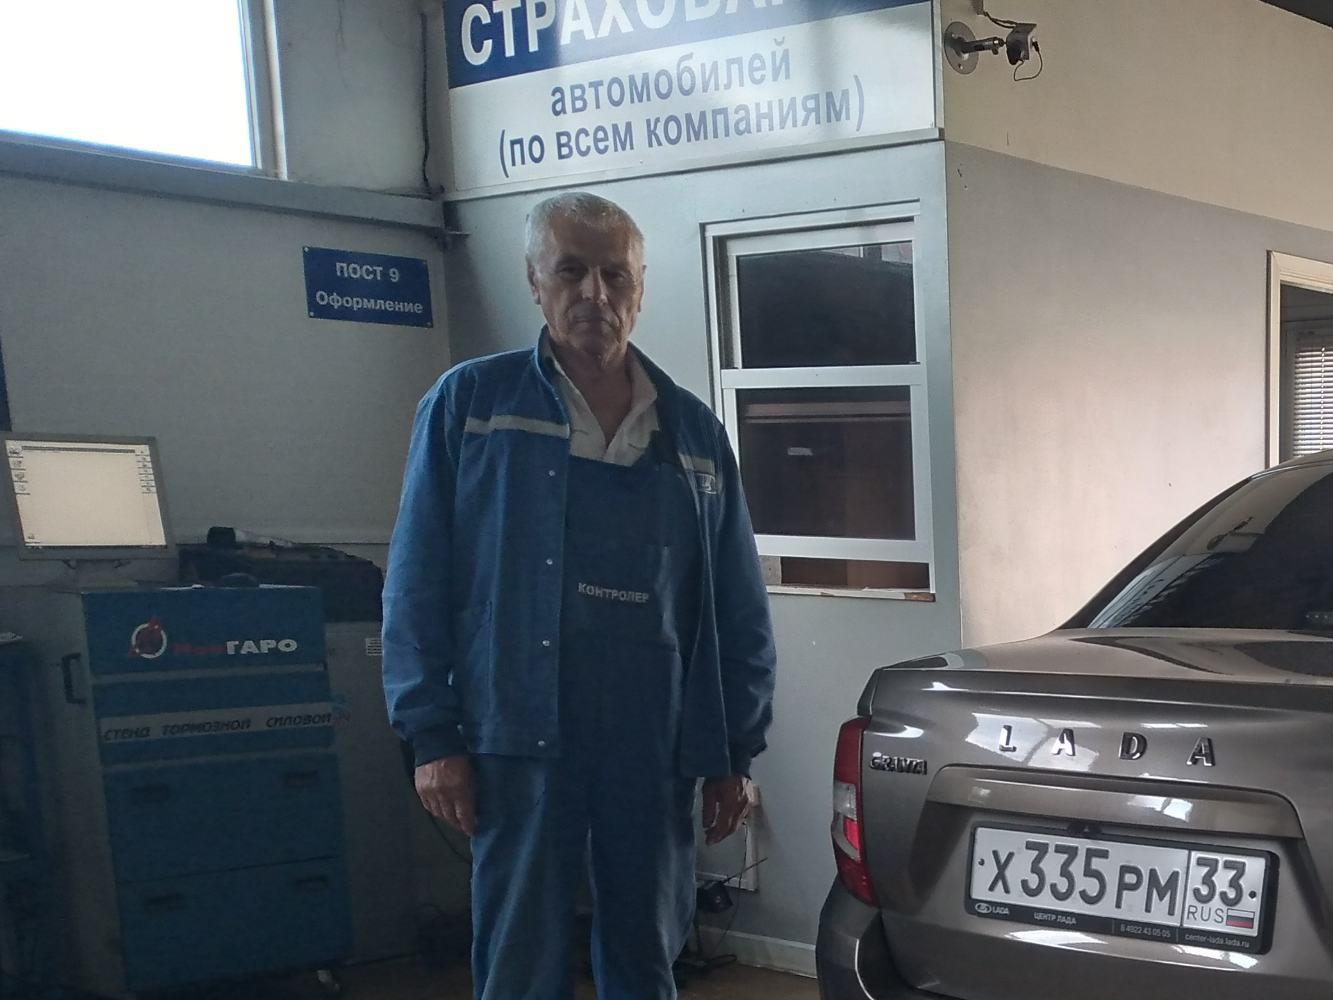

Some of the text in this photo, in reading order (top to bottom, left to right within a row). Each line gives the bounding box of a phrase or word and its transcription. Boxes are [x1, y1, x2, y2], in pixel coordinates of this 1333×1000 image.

[551, 37, 792, 118] автомобилей
[499, 74, 866, 178] (по всем компаниям)
[335, 262, 400, 283] ПОСТ 9
[315, 290, 424, 314] Оформление
[577, 582, 650, 604] КОНТРОЛЕР
[999, 724, 1216, 767] LADA
[1192, 856, 1247, 907] 33
[1034, 912, 1077, 925] ЦЕНТР ЛАДА
[1186, 905, 1225, 924] RUS
